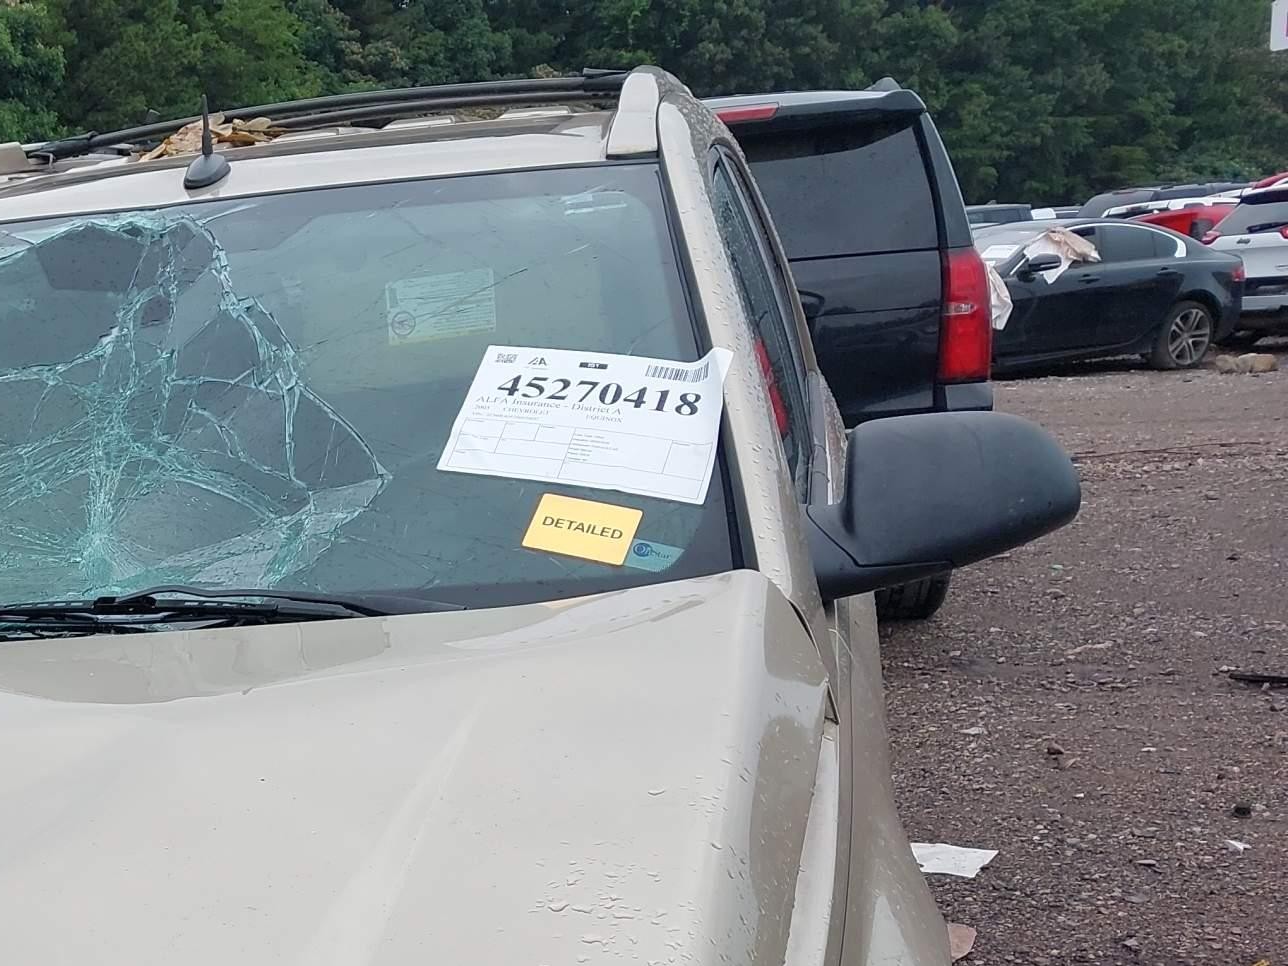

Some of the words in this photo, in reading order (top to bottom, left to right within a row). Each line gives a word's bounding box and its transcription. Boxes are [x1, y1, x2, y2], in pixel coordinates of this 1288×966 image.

[475, 395, 508, 405] ALFA
[512, 398, 561, 409] Insurance
[571, 403, 609, 414] District
[497, 374, 702, 416] 45270418
[541, 515, 624, 541] DETAILED
